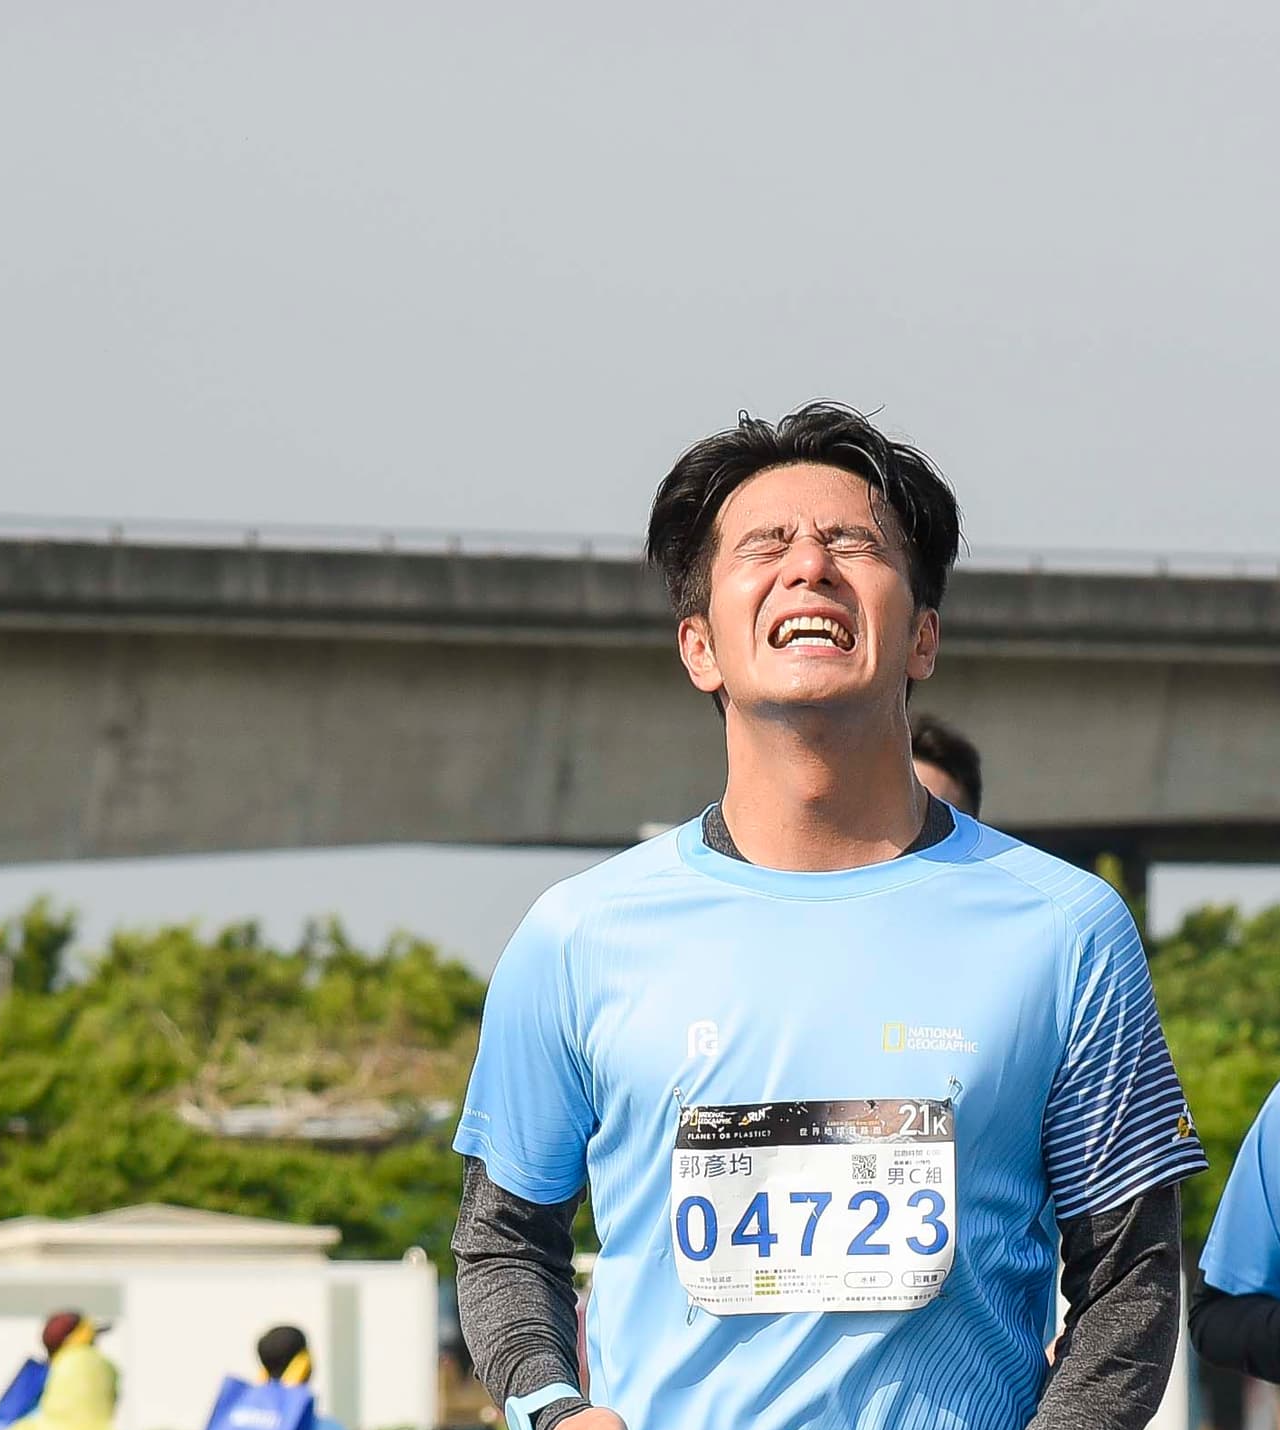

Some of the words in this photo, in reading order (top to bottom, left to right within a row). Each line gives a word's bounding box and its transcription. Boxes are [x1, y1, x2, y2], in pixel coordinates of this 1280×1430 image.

[679, 1152, 753, 1178] 郭彥均
[676, 1188, 950, 1262] 04723
